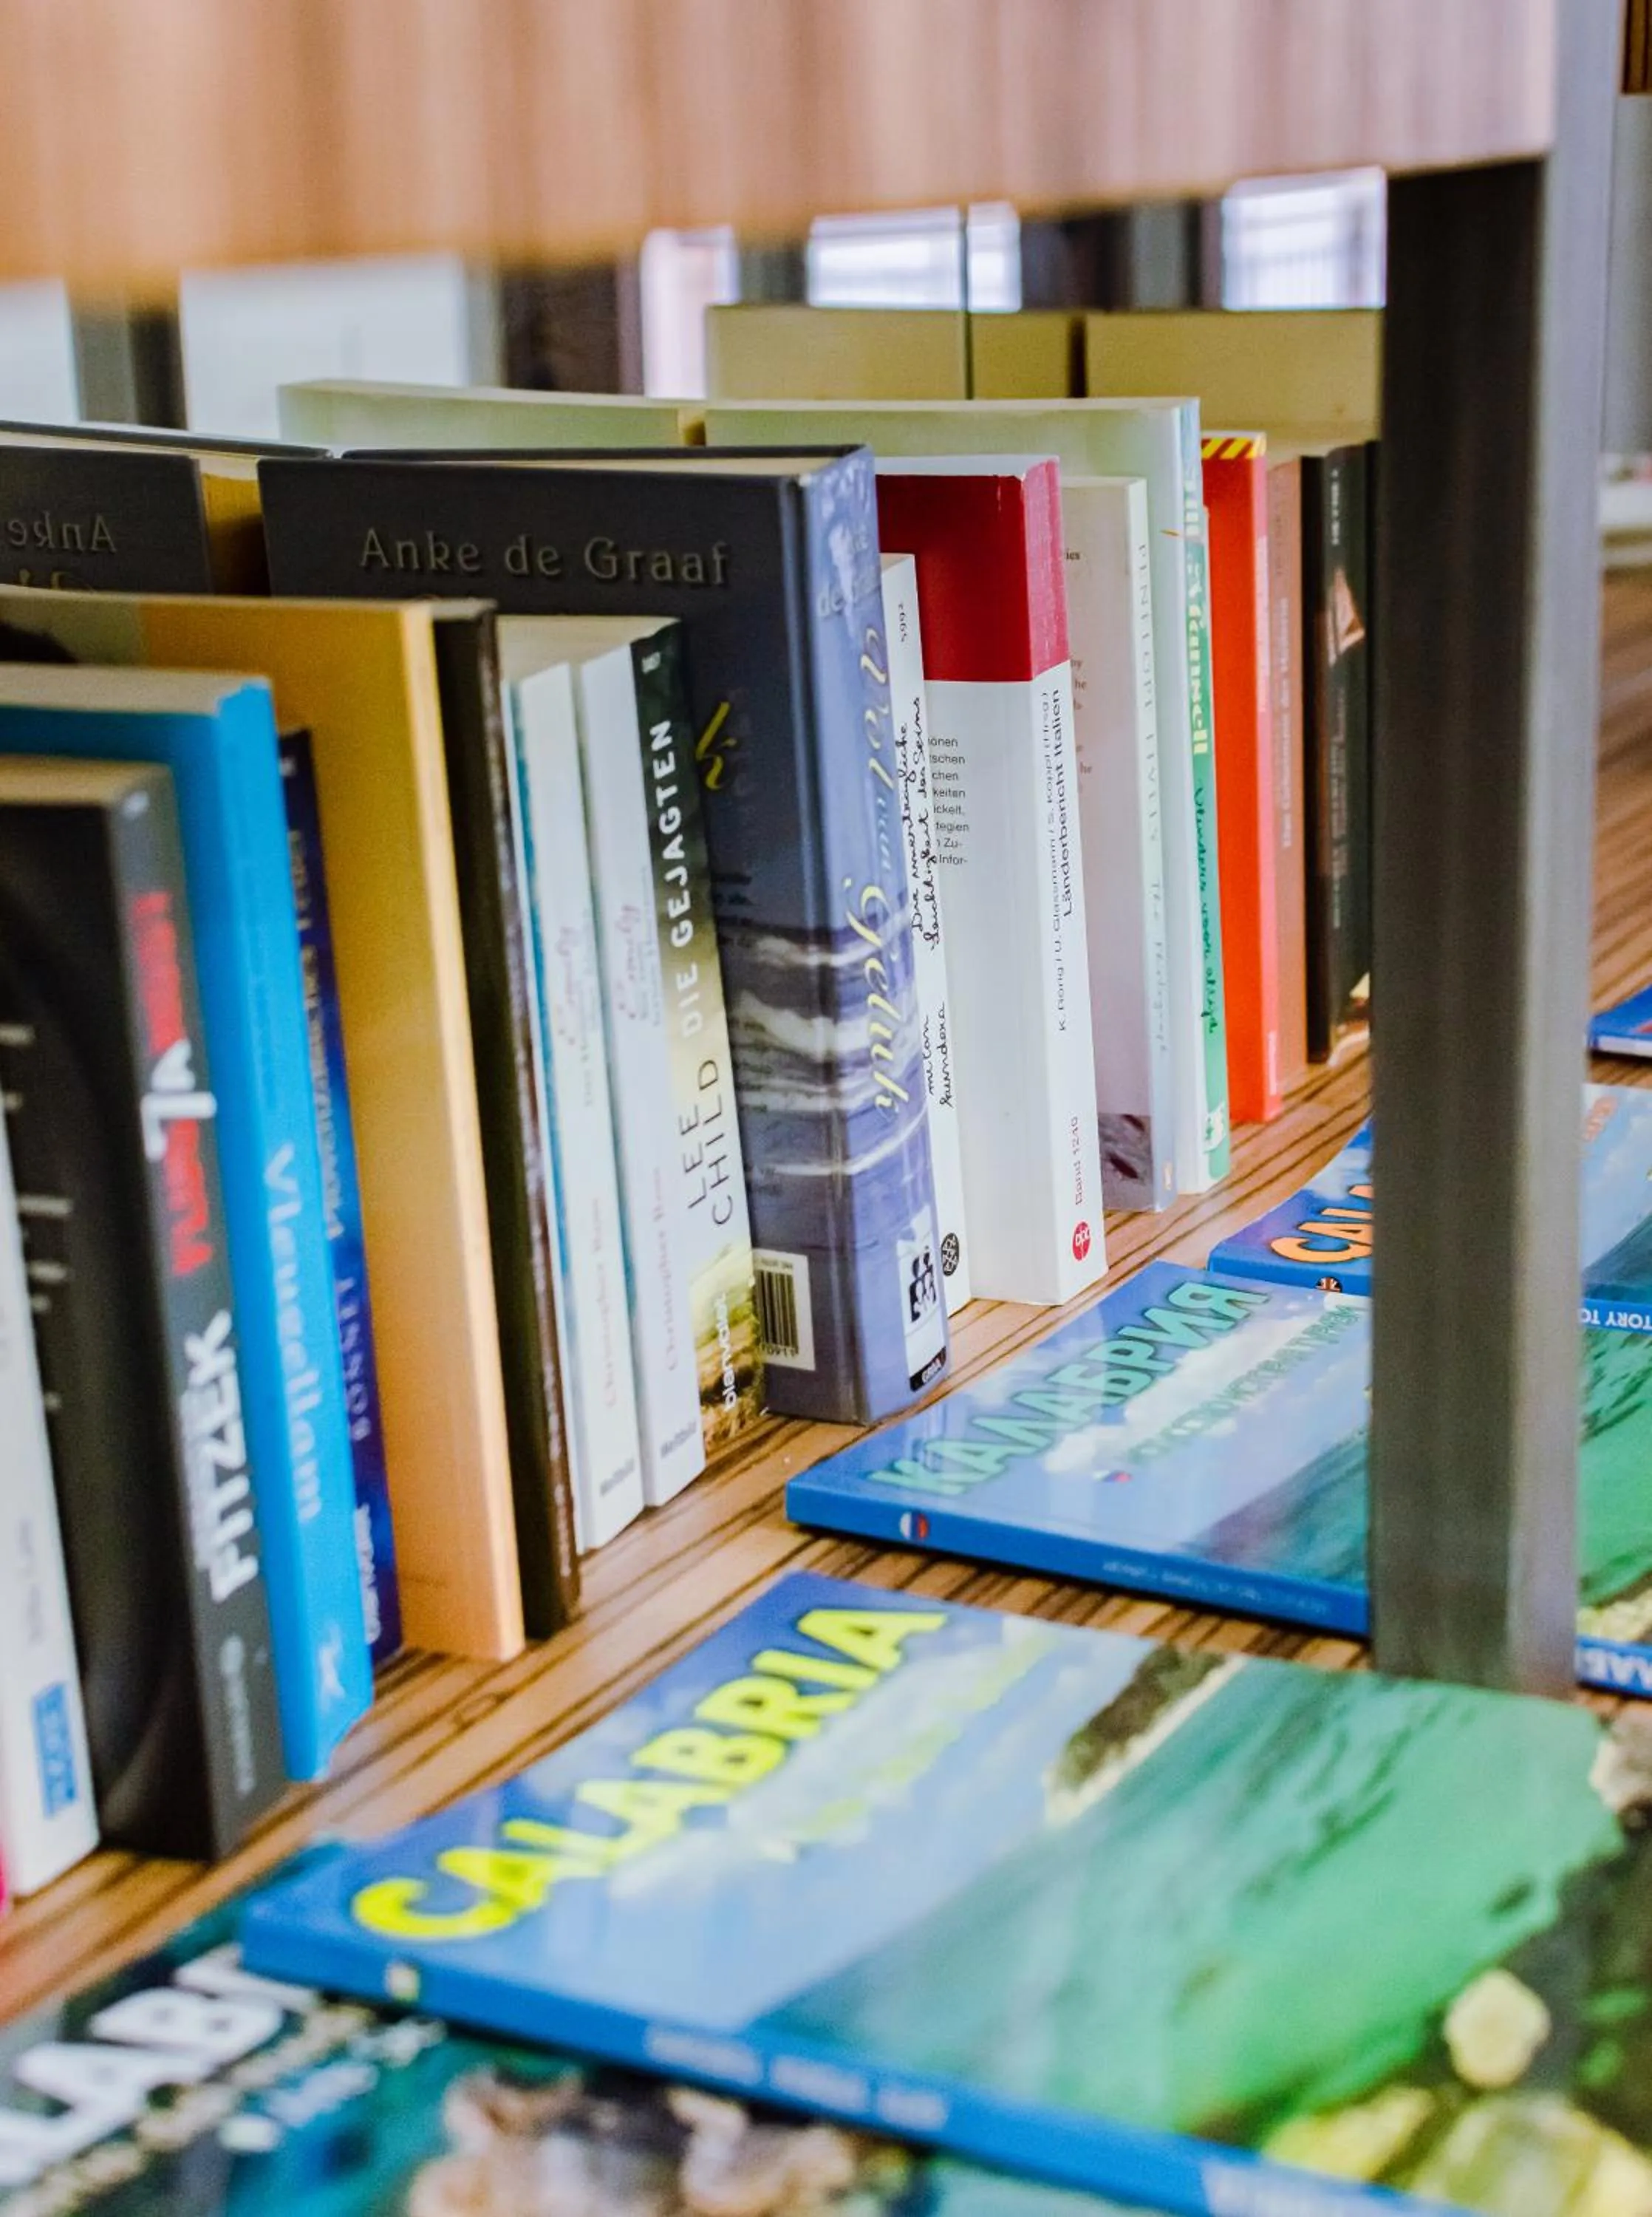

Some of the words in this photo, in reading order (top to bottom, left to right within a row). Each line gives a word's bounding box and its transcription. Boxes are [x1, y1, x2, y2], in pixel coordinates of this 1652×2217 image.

[361, 527, 481, 572] Anke
[505, 534, 562, 577] de
[583, 536, 732, 586] Graaf
[1052, 689, 1063, 758] Italien
[649, 720, 694, 948] GEJAGTEN
[1055, 763, 1073, 917] Länderbericht
[676, 962, 702, 1039] DIE
[678, 1103, 708, 1209] LEE
[697, 1058, 734, 1225] CHILD
[185, 1308, 259, 1604] FITZEK
[867, 1281, 1270, 1496] КАЛАБРИЯ
[351, 1607, 948, 1941] CALABRIA
